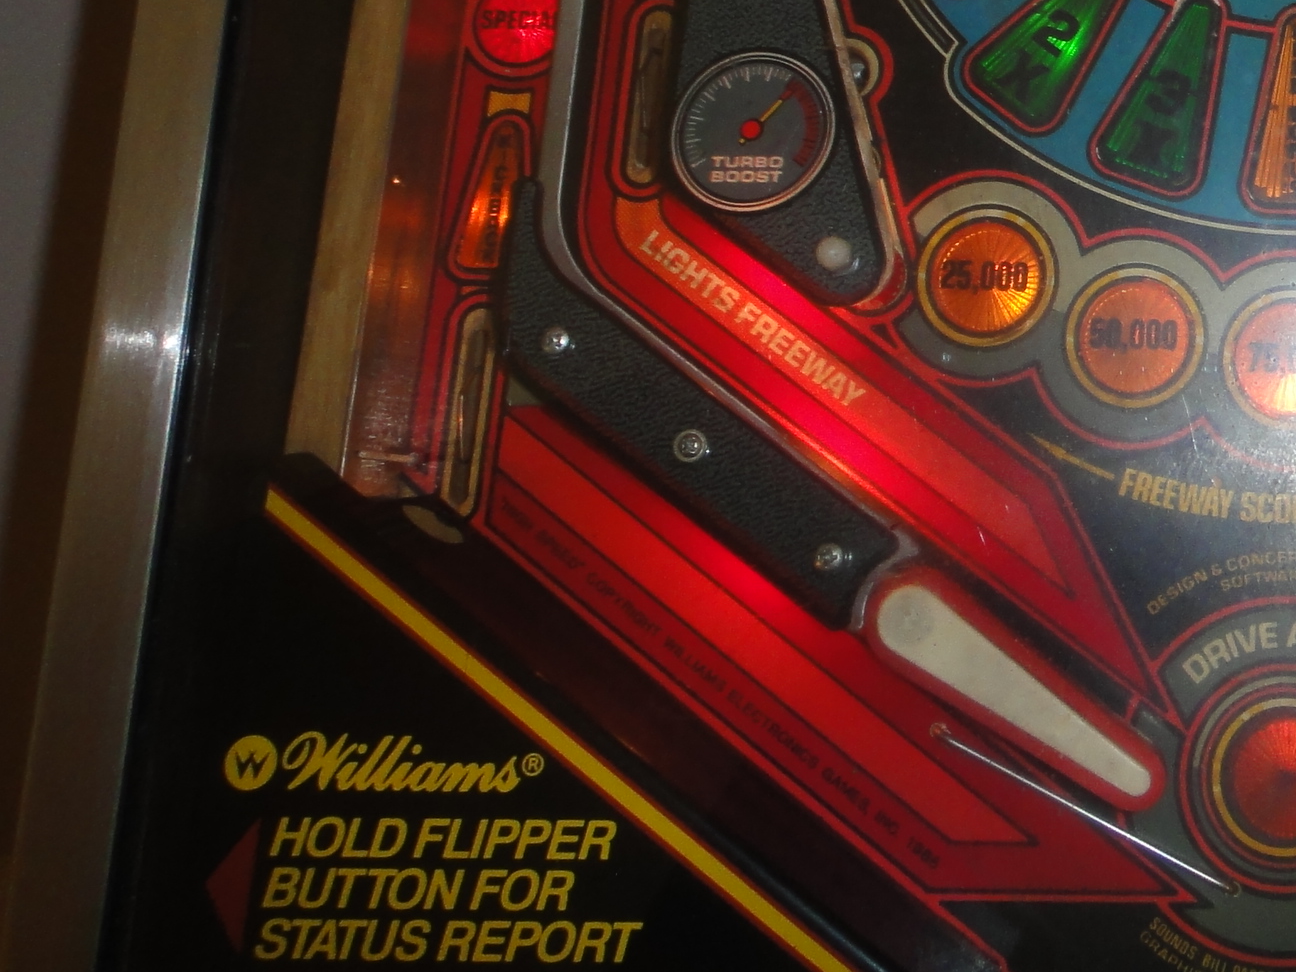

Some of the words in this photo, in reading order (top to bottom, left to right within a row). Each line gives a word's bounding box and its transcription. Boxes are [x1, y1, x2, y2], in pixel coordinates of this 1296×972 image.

[711, 155, 785, 168] TURBO
[711, 170, 783, 184] BOOST
[940, 258, 1029, 294] 25,000
[638, 229, 741, 313] LIGHTS
[734, 302, 867, 406] FREEWAY
[1118, 467, 1235, 520] FREEWAY
[1146, 569, 1208, 615] DESIGN
[584, 569, 662, 638] COPYRIGHT
[659, 635, 726, 694] WILLIAMS
[724, 688, 820, 770] ELECTRONICS
[1181, 621, 1279, 685] DRIVE
[268, 816, 409, 859] HOLD
[413, 817, 618, 861] FLIPPER
[261, 866, 465, 911] BUTTON
[469, 868, 576, 912] FOR
[253, 917, 431, 962] STATUS
[436, 920, 644, 964] REPORT
[1149, 916, 1198, 960] SOUNDS
